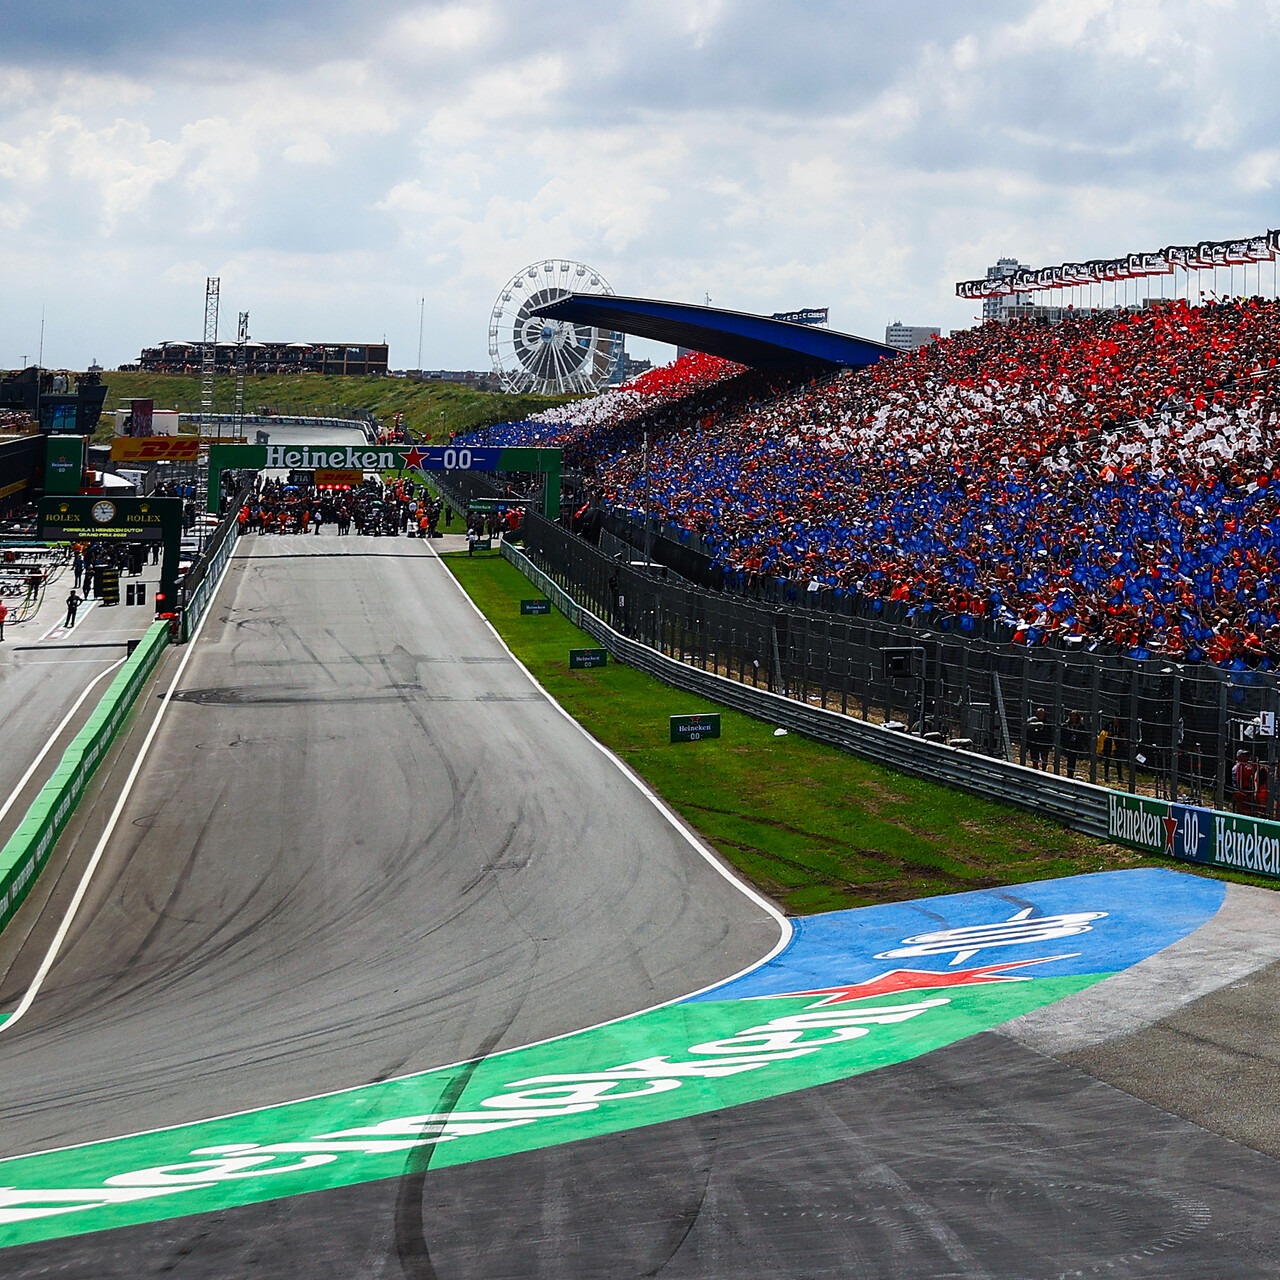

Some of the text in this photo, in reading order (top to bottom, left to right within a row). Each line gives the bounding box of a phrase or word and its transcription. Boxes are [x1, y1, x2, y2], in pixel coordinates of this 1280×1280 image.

[265, 446, 471, 470] Heineken 0.0
[679, 724, 711, 732] Heineken
[1109, 795, 1199, 857] Heineken 0.0
[1215, 816, 1280, 874] Heineken
